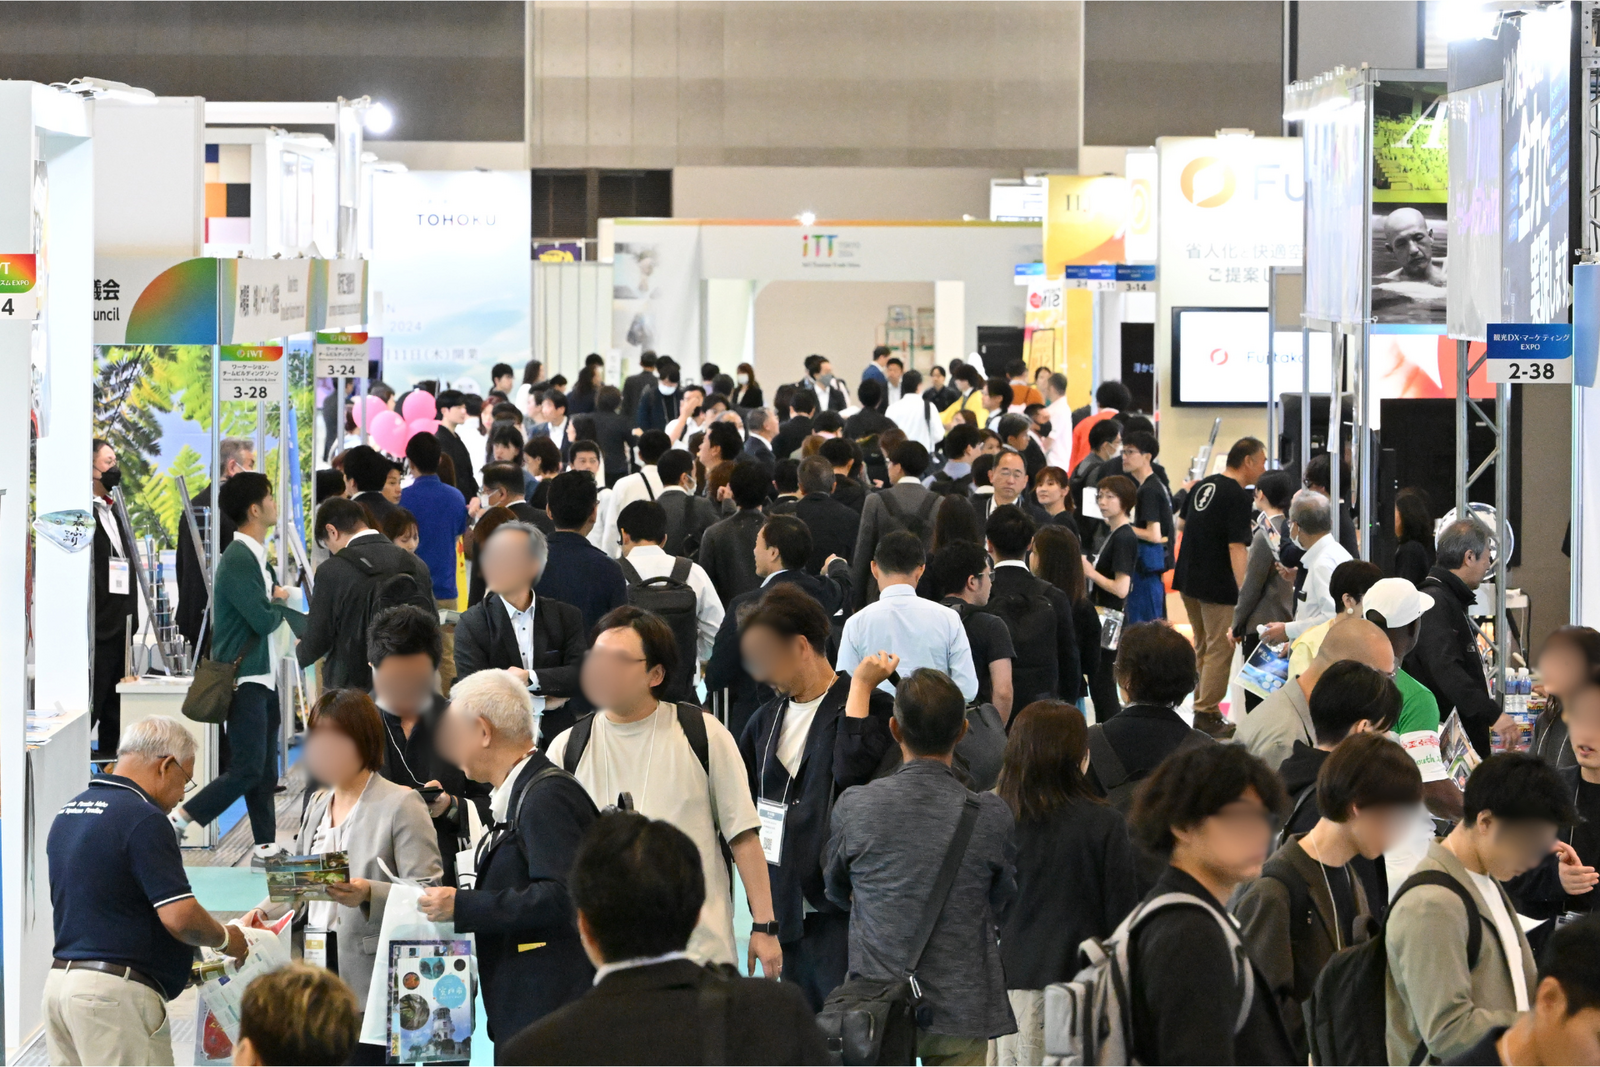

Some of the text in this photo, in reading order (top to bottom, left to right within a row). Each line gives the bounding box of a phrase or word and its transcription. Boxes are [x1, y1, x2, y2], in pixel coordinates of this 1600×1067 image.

[416, 214, 496, 226] TOHOKU
[802, 234, 839, 258] iTT
[1126, 283, 1147, 291] 3-14
[1, 298, 15, 316] 4
[390, 321, 422, 332] 2024
[1520, 343, 1541, 351] EXPO
[246, 350, 264, 358] iWT
[327, 365, 356, 376] 3-24
[1508, 362, 1555, 380] 2-38
[233, 386, 268, 399] 3-28
